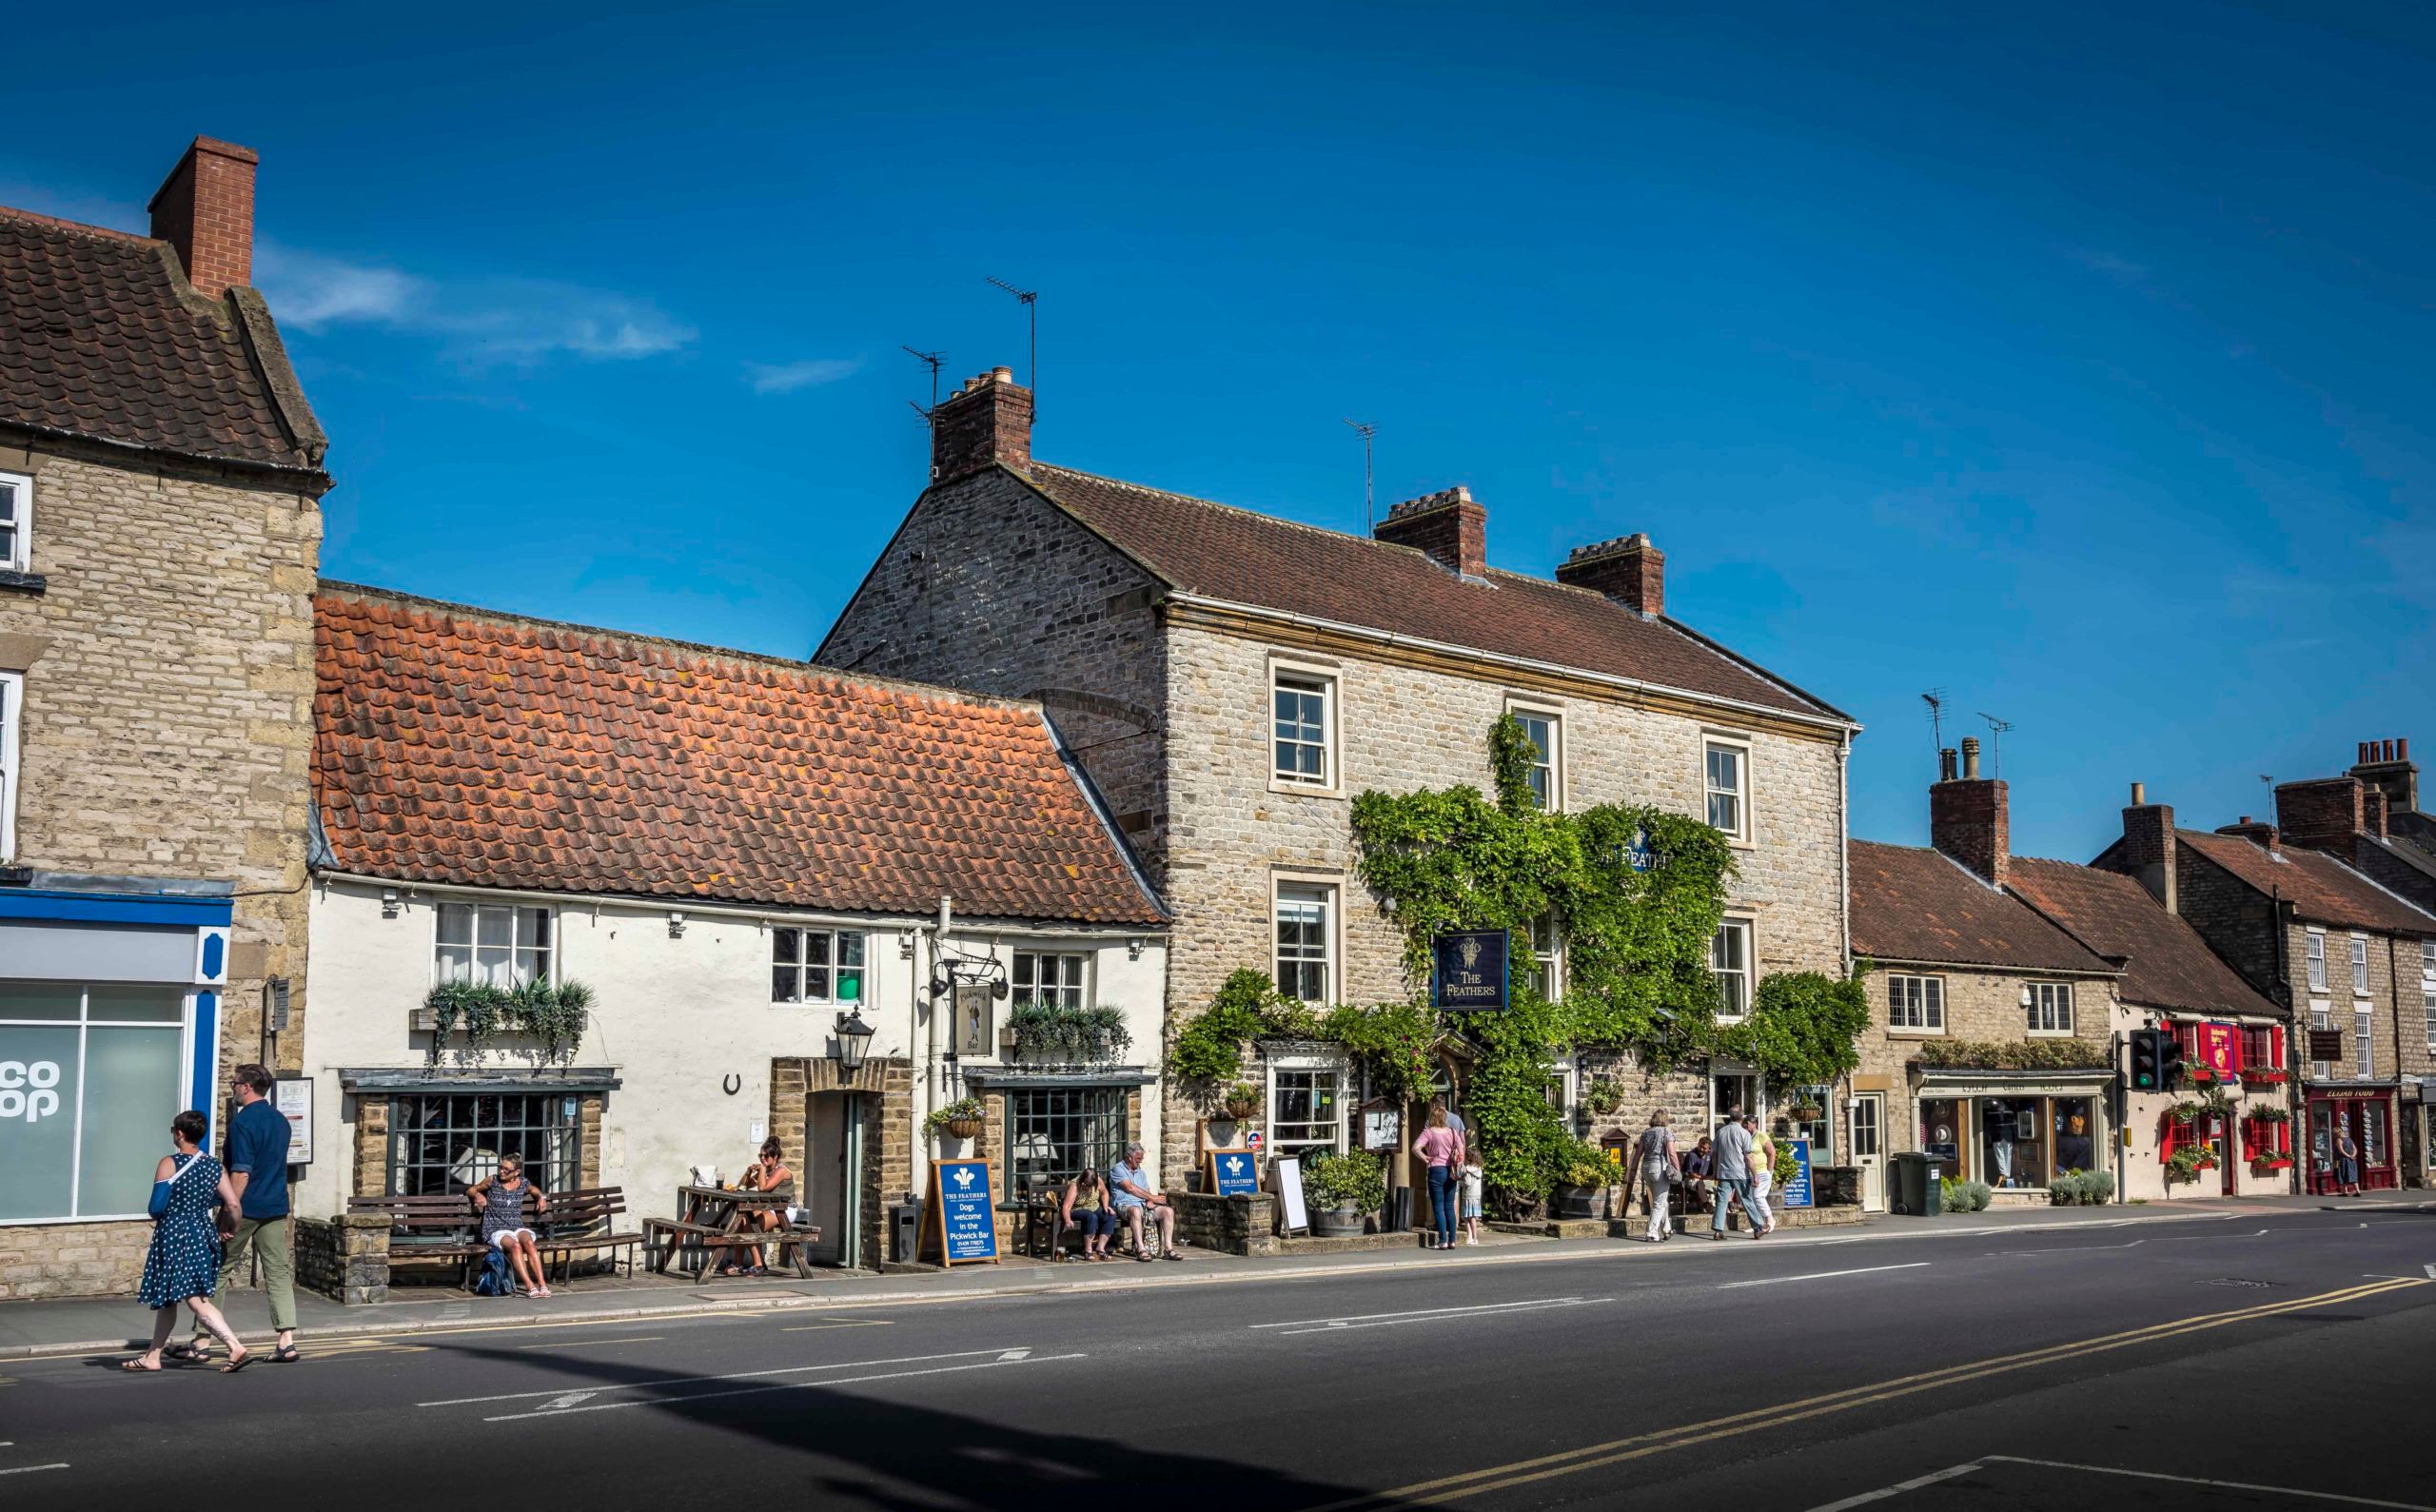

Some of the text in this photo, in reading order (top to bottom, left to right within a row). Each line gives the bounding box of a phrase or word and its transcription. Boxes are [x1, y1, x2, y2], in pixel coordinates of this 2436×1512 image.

[1460, 971, 1482, 984] THE
[1446, 984, 1496, 996] FEATHERS
[959, 990, 987, 1002] Pickwick
[967, 1040, 979, 1050] Bar
[959, 1203, 975, 1212] Dogs
[950, 1230, 989, 1240] Pickwick Bar
